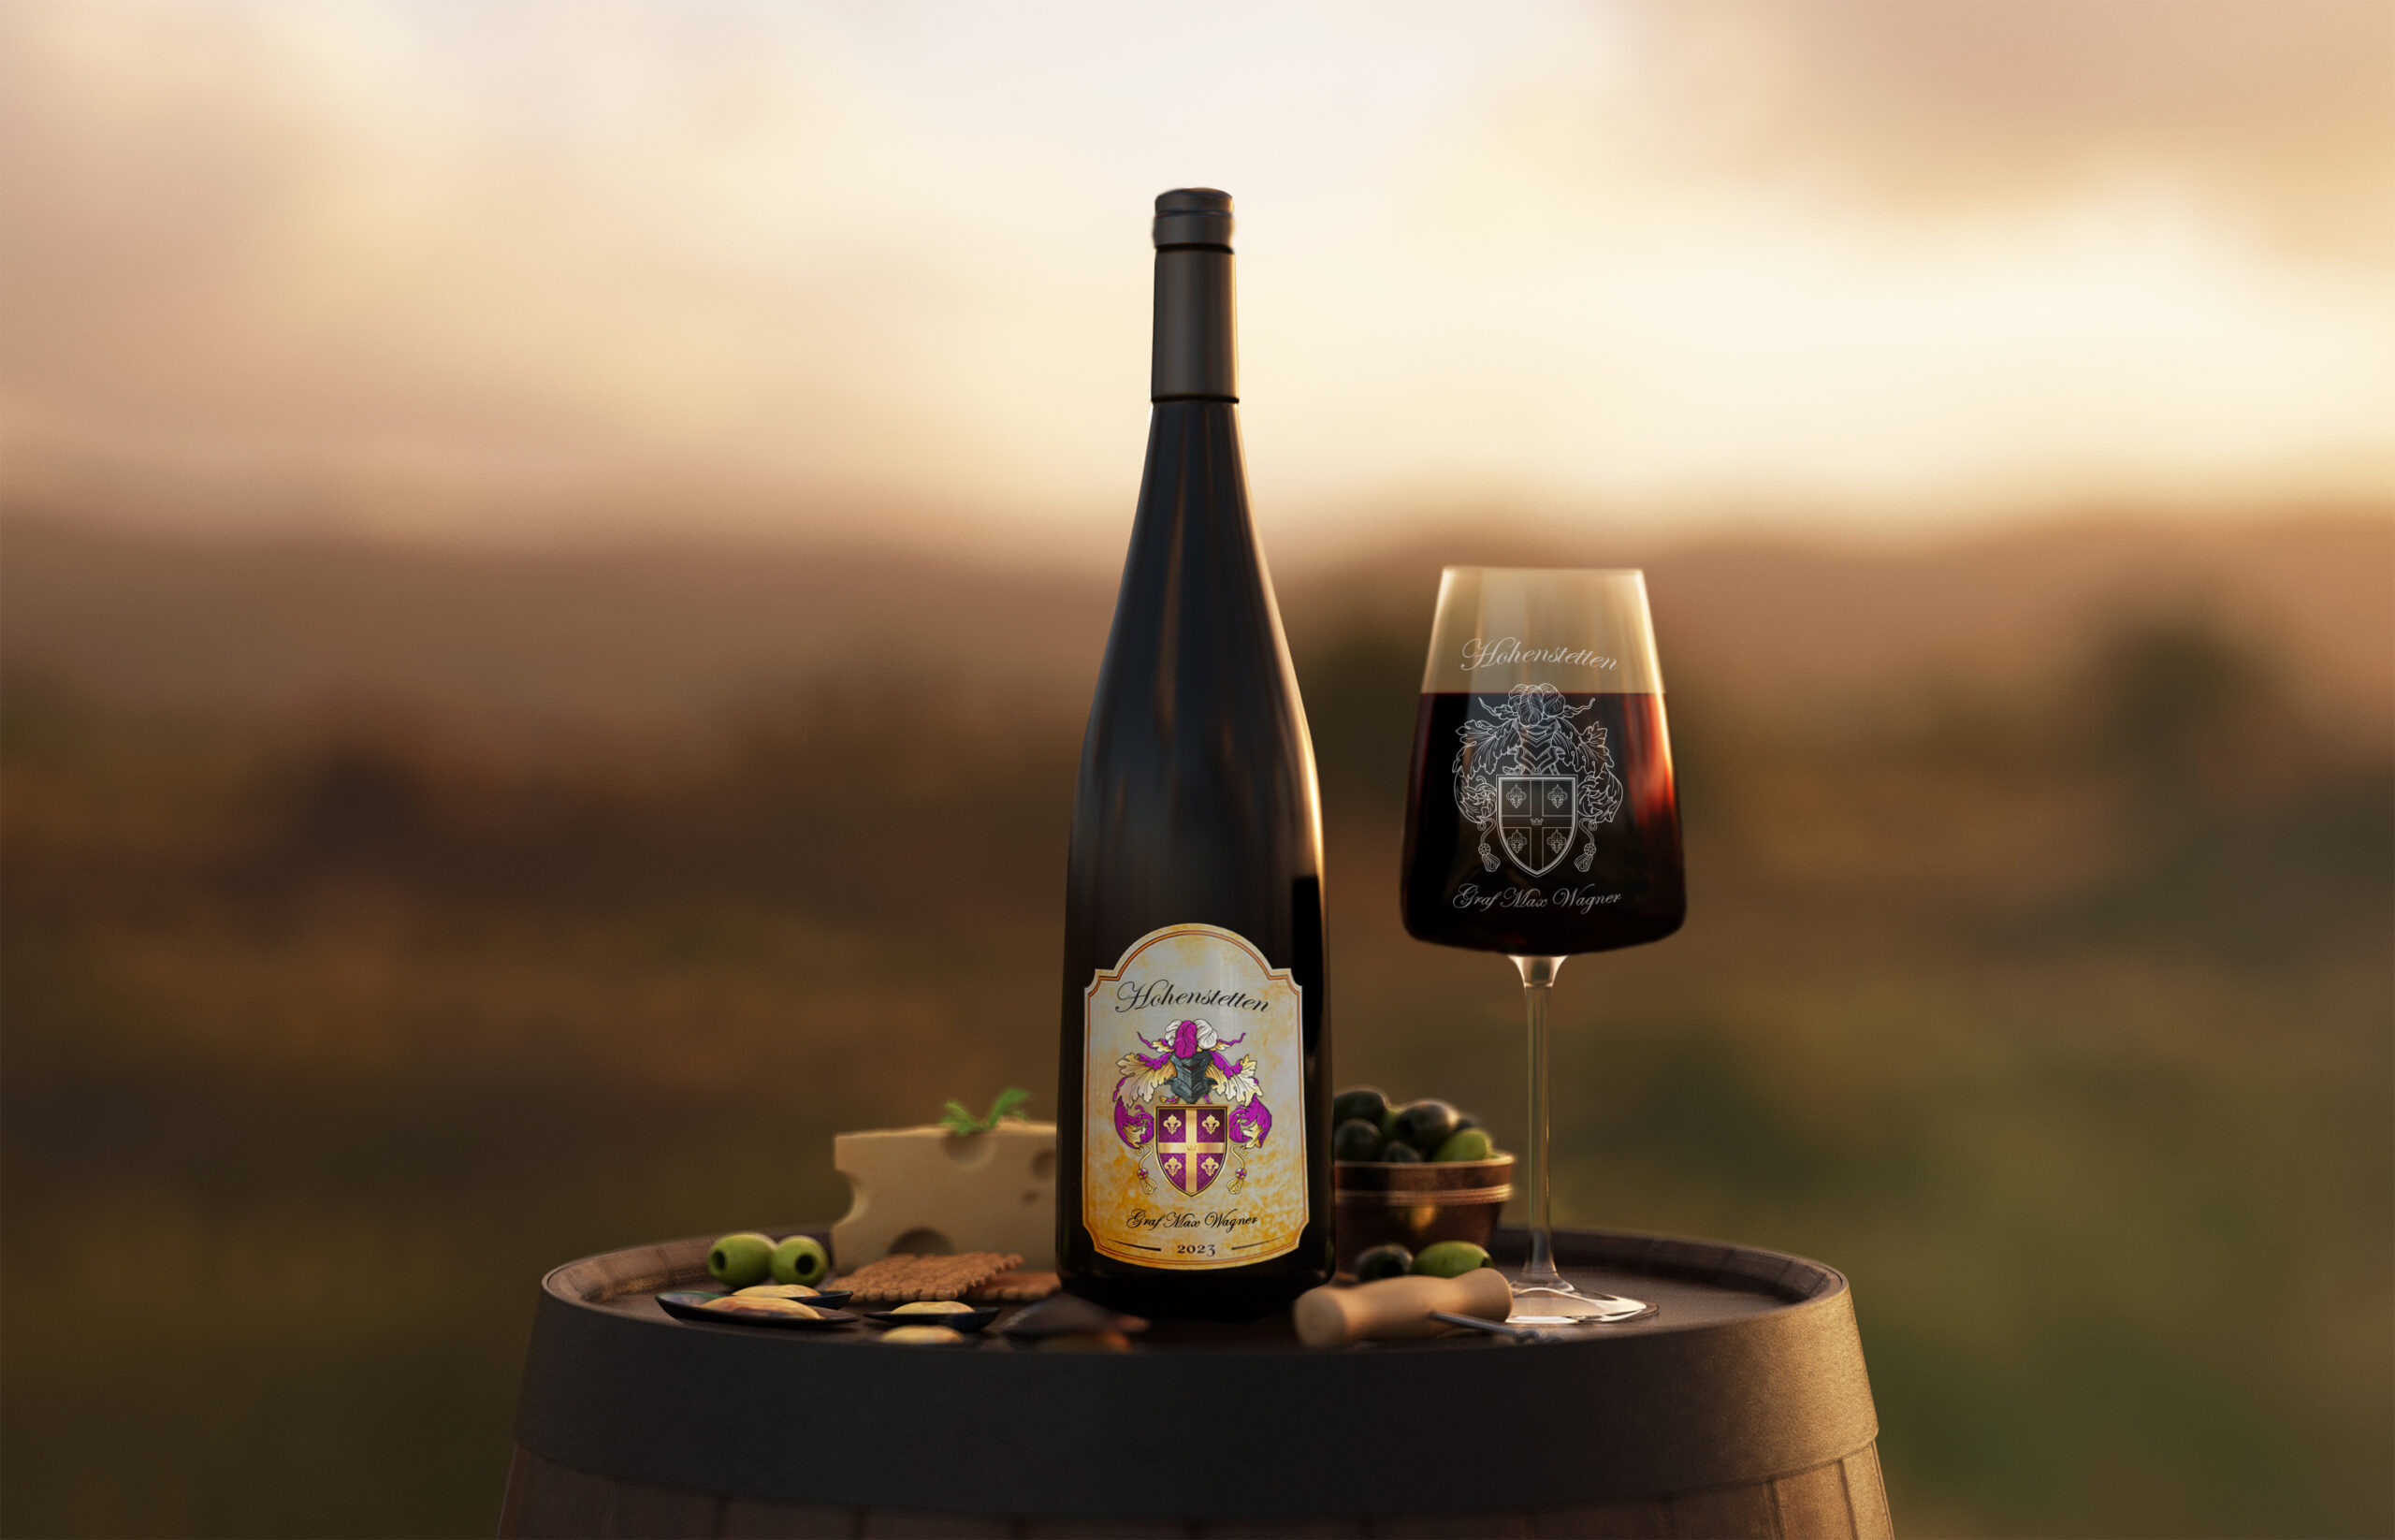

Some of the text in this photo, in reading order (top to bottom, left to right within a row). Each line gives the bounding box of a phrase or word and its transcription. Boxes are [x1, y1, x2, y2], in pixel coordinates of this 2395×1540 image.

[1460, 636, 1619, 671] Hohenstetten
[1452, 883, 1622, 914] Graf Max Wagner
[1114, 979, 1271, 1013] Hohenstetten
[1126, 1208, 1258, 1234] Graf Max Wagner
[1177, 1244, 1216, 1257] 2023
